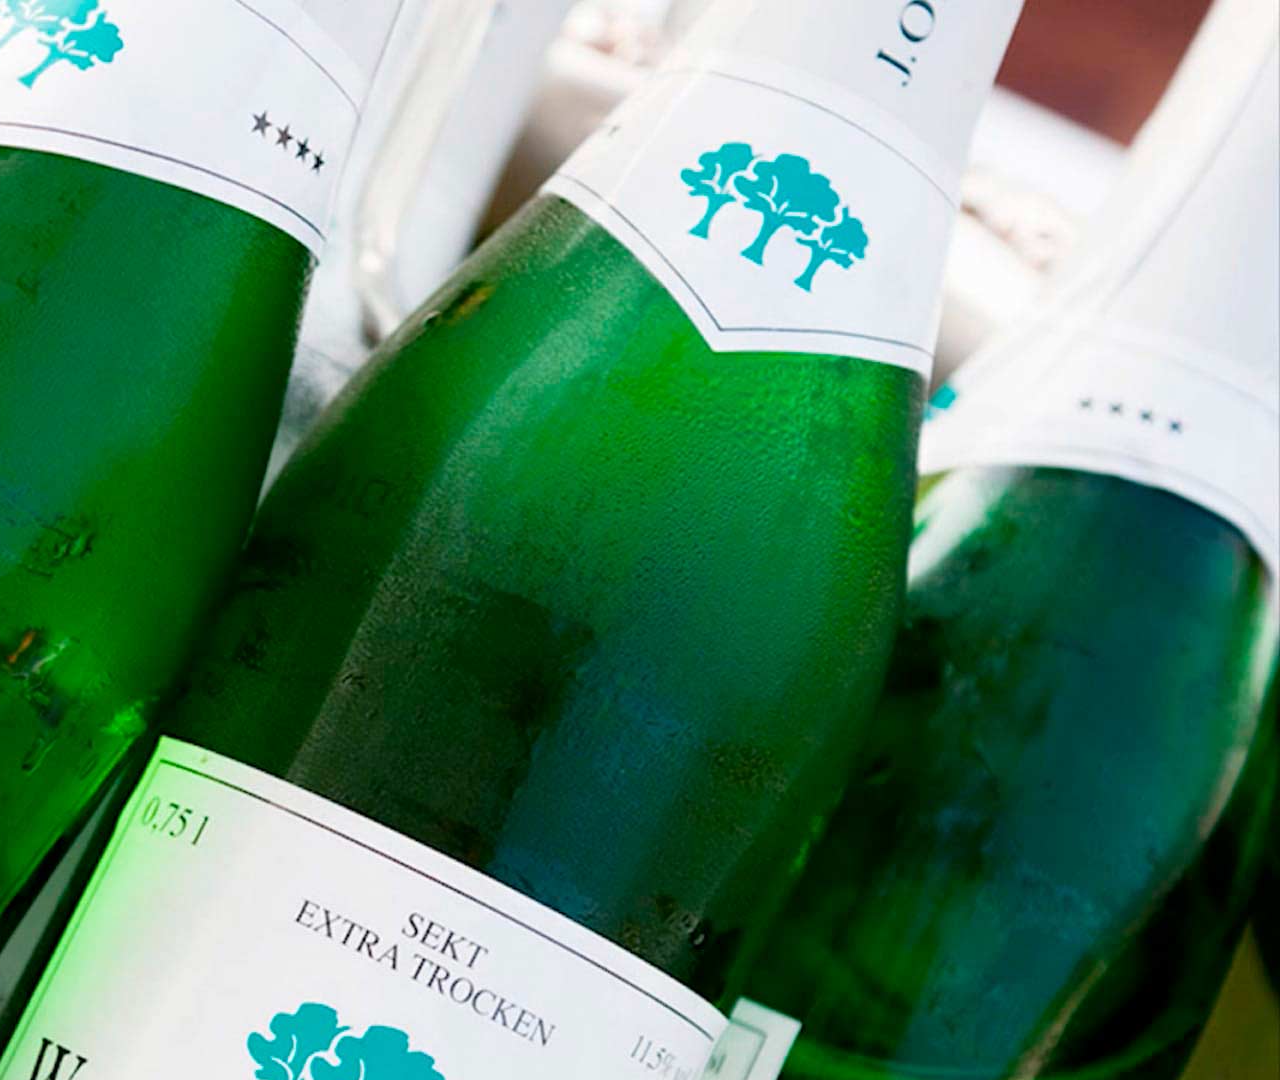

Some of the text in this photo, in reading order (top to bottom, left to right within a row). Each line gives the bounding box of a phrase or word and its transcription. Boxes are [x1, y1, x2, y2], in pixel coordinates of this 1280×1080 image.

[294, 899, 557, 1047] EXTRA TROCKEN
[401, 911, 489, 969] SEKT
